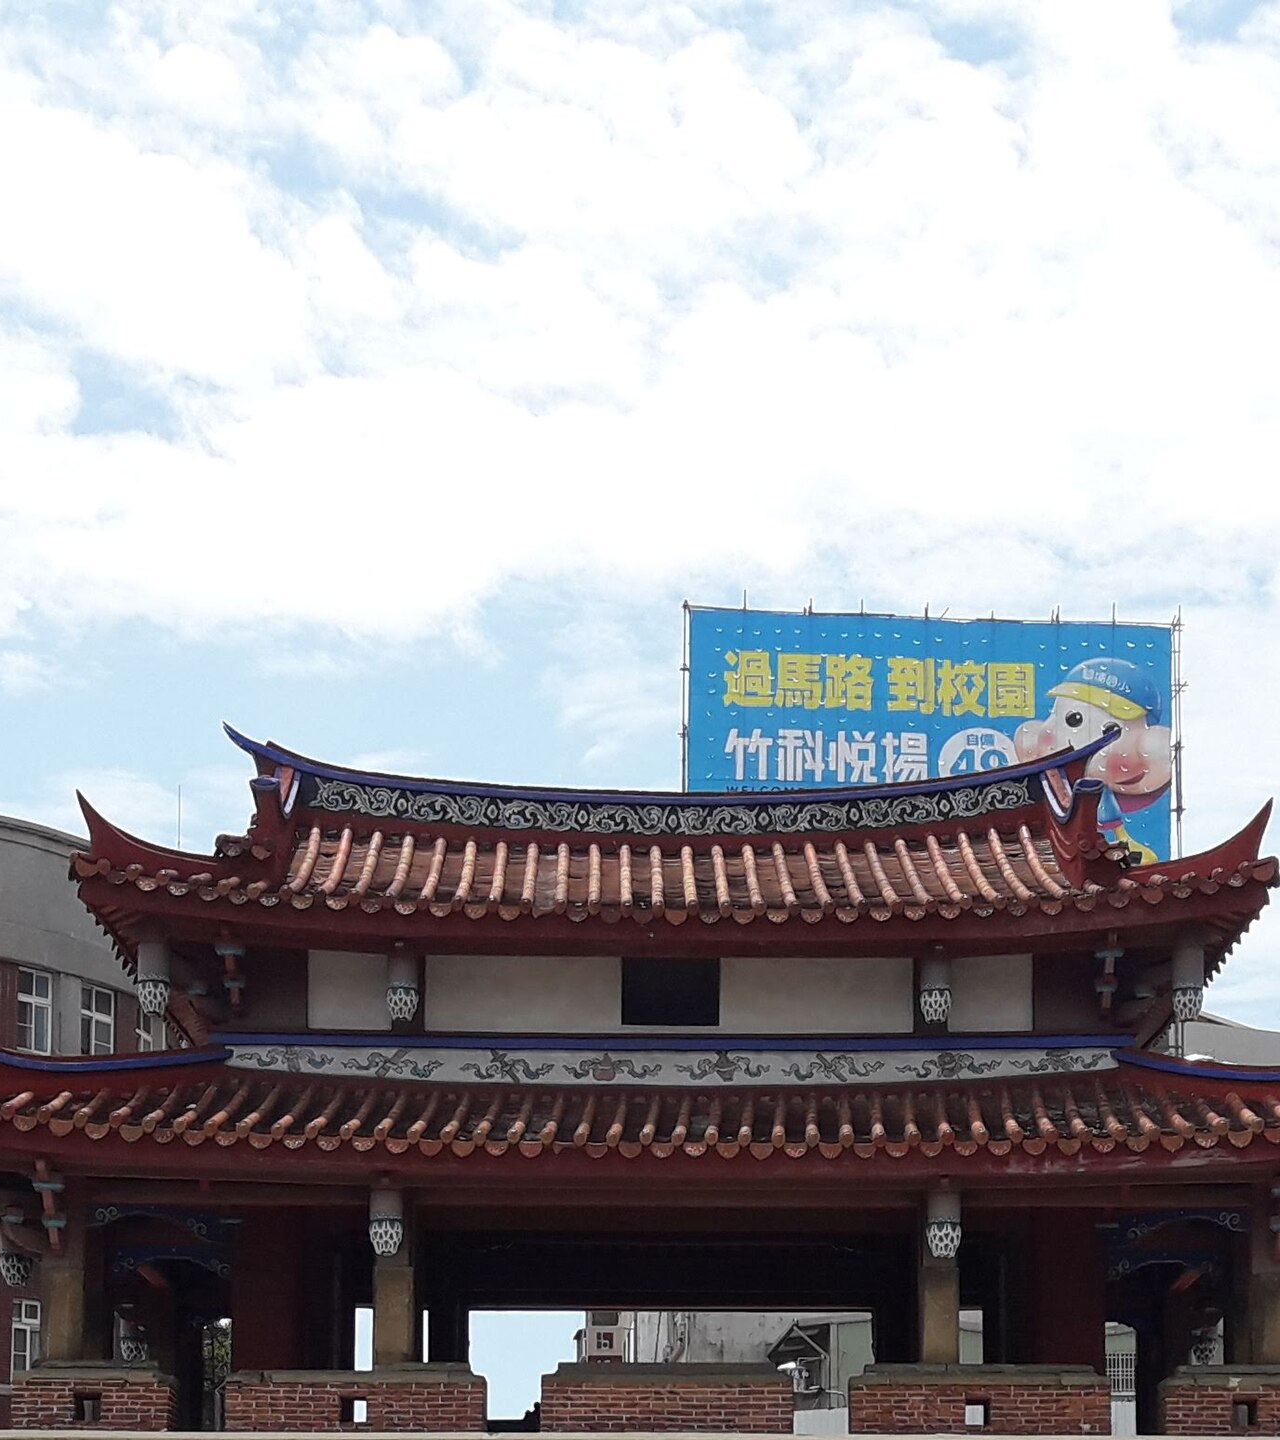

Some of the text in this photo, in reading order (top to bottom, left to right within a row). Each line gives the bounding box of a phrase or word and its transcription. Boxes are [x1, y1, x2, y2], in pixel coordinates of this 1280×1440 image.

[723, 650, 1036, 719] 過馬路 到校園
[724, 728, 929, 784] 竹科悅揚
